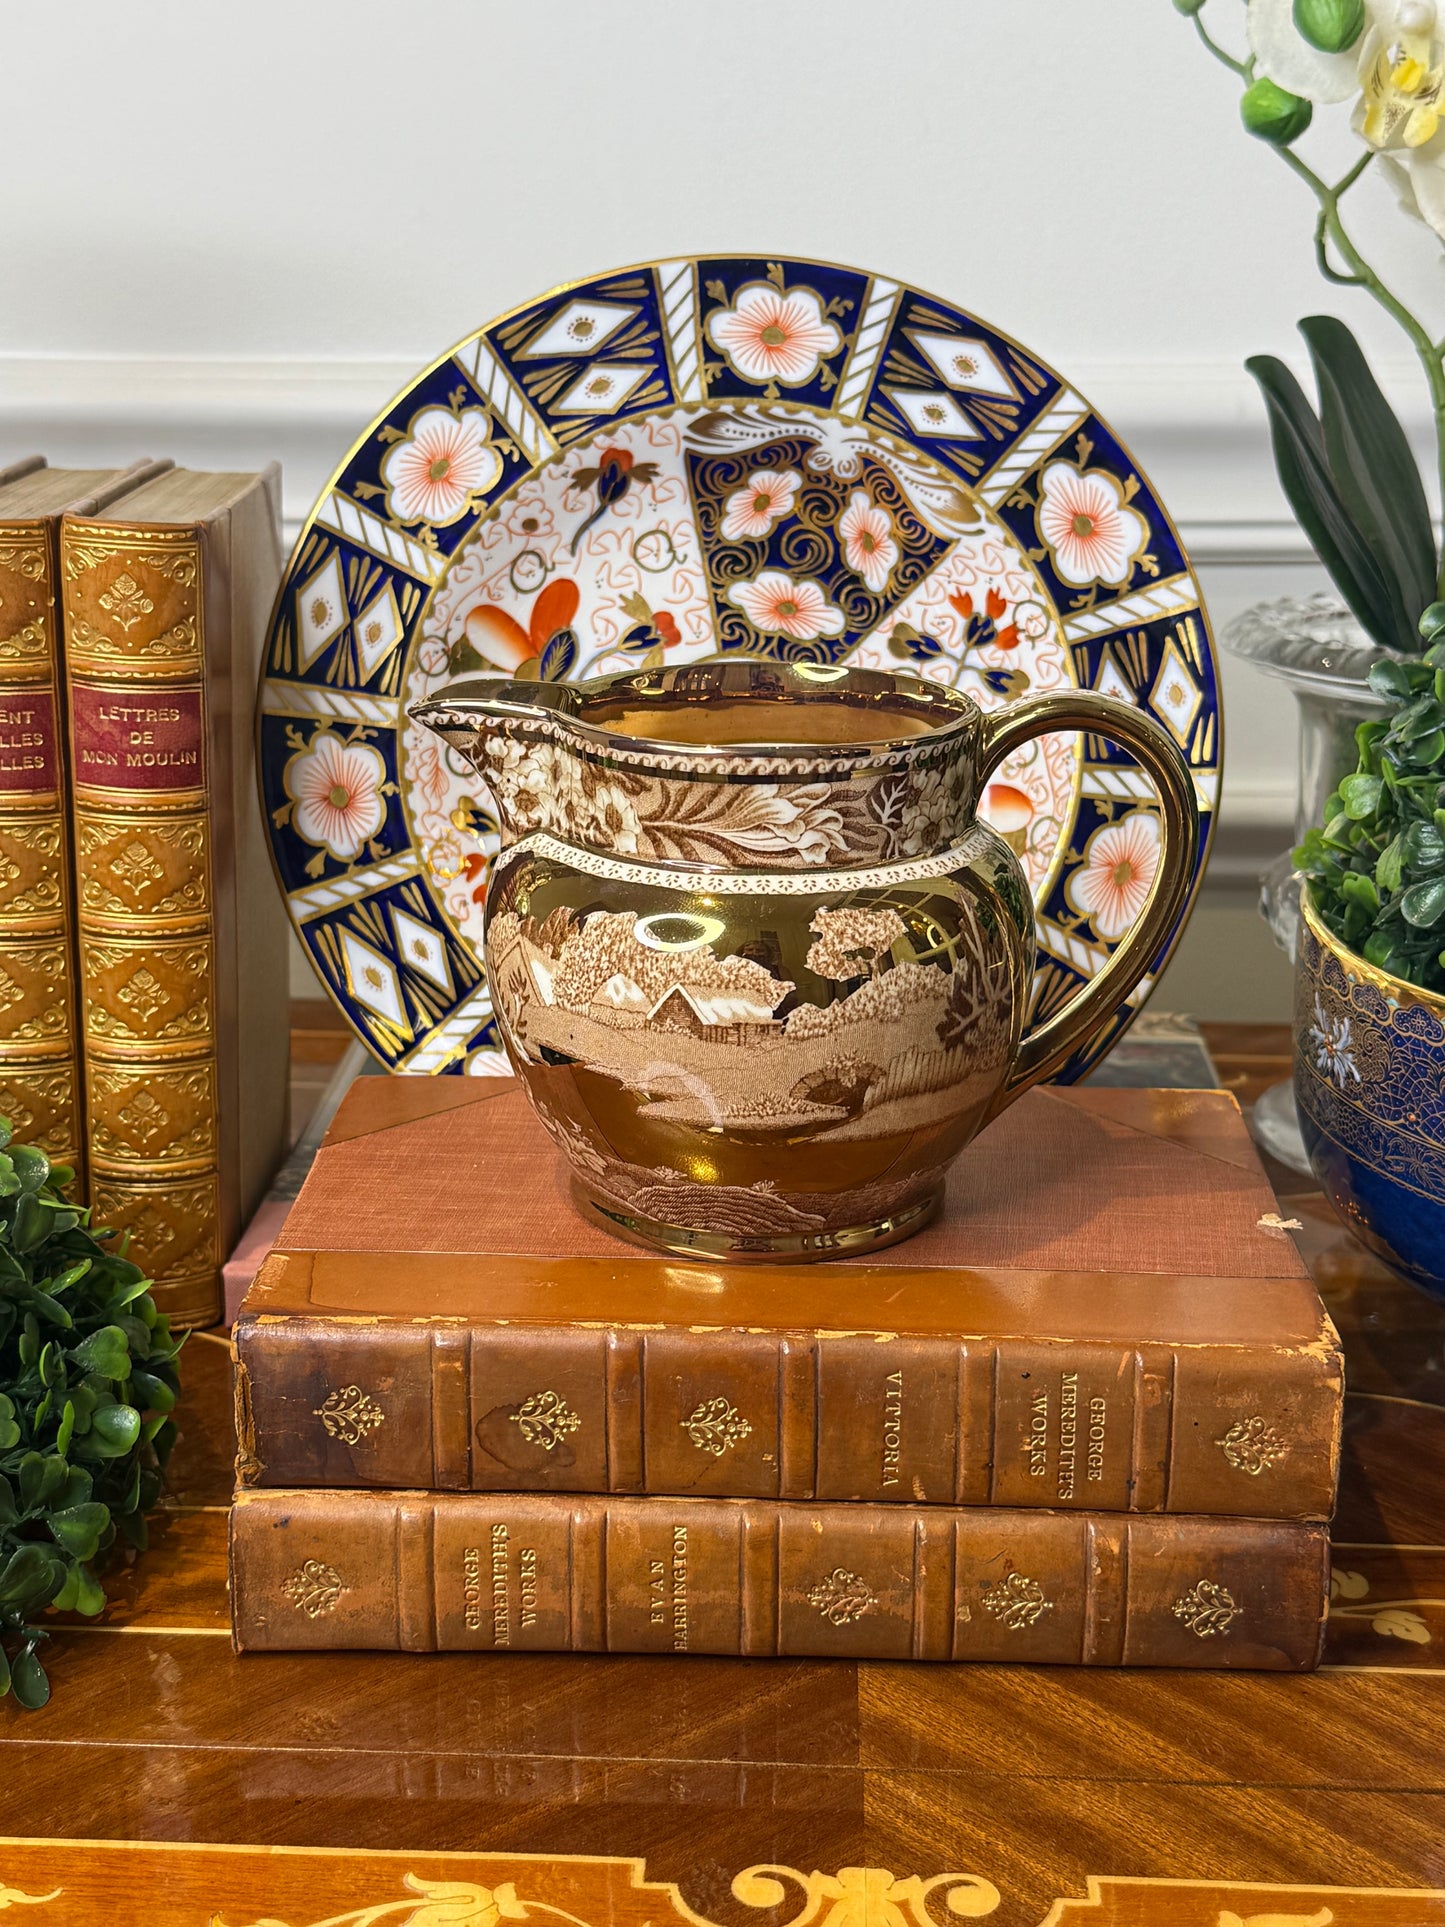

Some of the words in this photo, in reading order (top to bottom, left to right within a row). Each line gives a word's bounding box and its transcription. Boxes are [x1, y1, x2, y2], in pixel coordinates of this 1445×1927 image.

[99, 706, 180, 722] LETTRES
[129, 731, 154, 745] DE
[81, 749, 118, 766] MON
[126, 751, 197, 767] MOULIN
[882, 1370, 902, 1487] VITTORIA
[1030, 1395, 1048, 1476] WORKS
[1058, 1372, 1078, 1500] MEREDITH'S
[1087, 1397, 1106, 1481] GEORGE
[464, 1548, 480, 1630] GEORGE
[492, 1524, 510, 1646] MEREDITH'S
[521, 1549, 537, 1628] WORKS
[651, 1561, 664, 1624] EVAN
[673, 1526, 688, 1650] HARRINGTON
